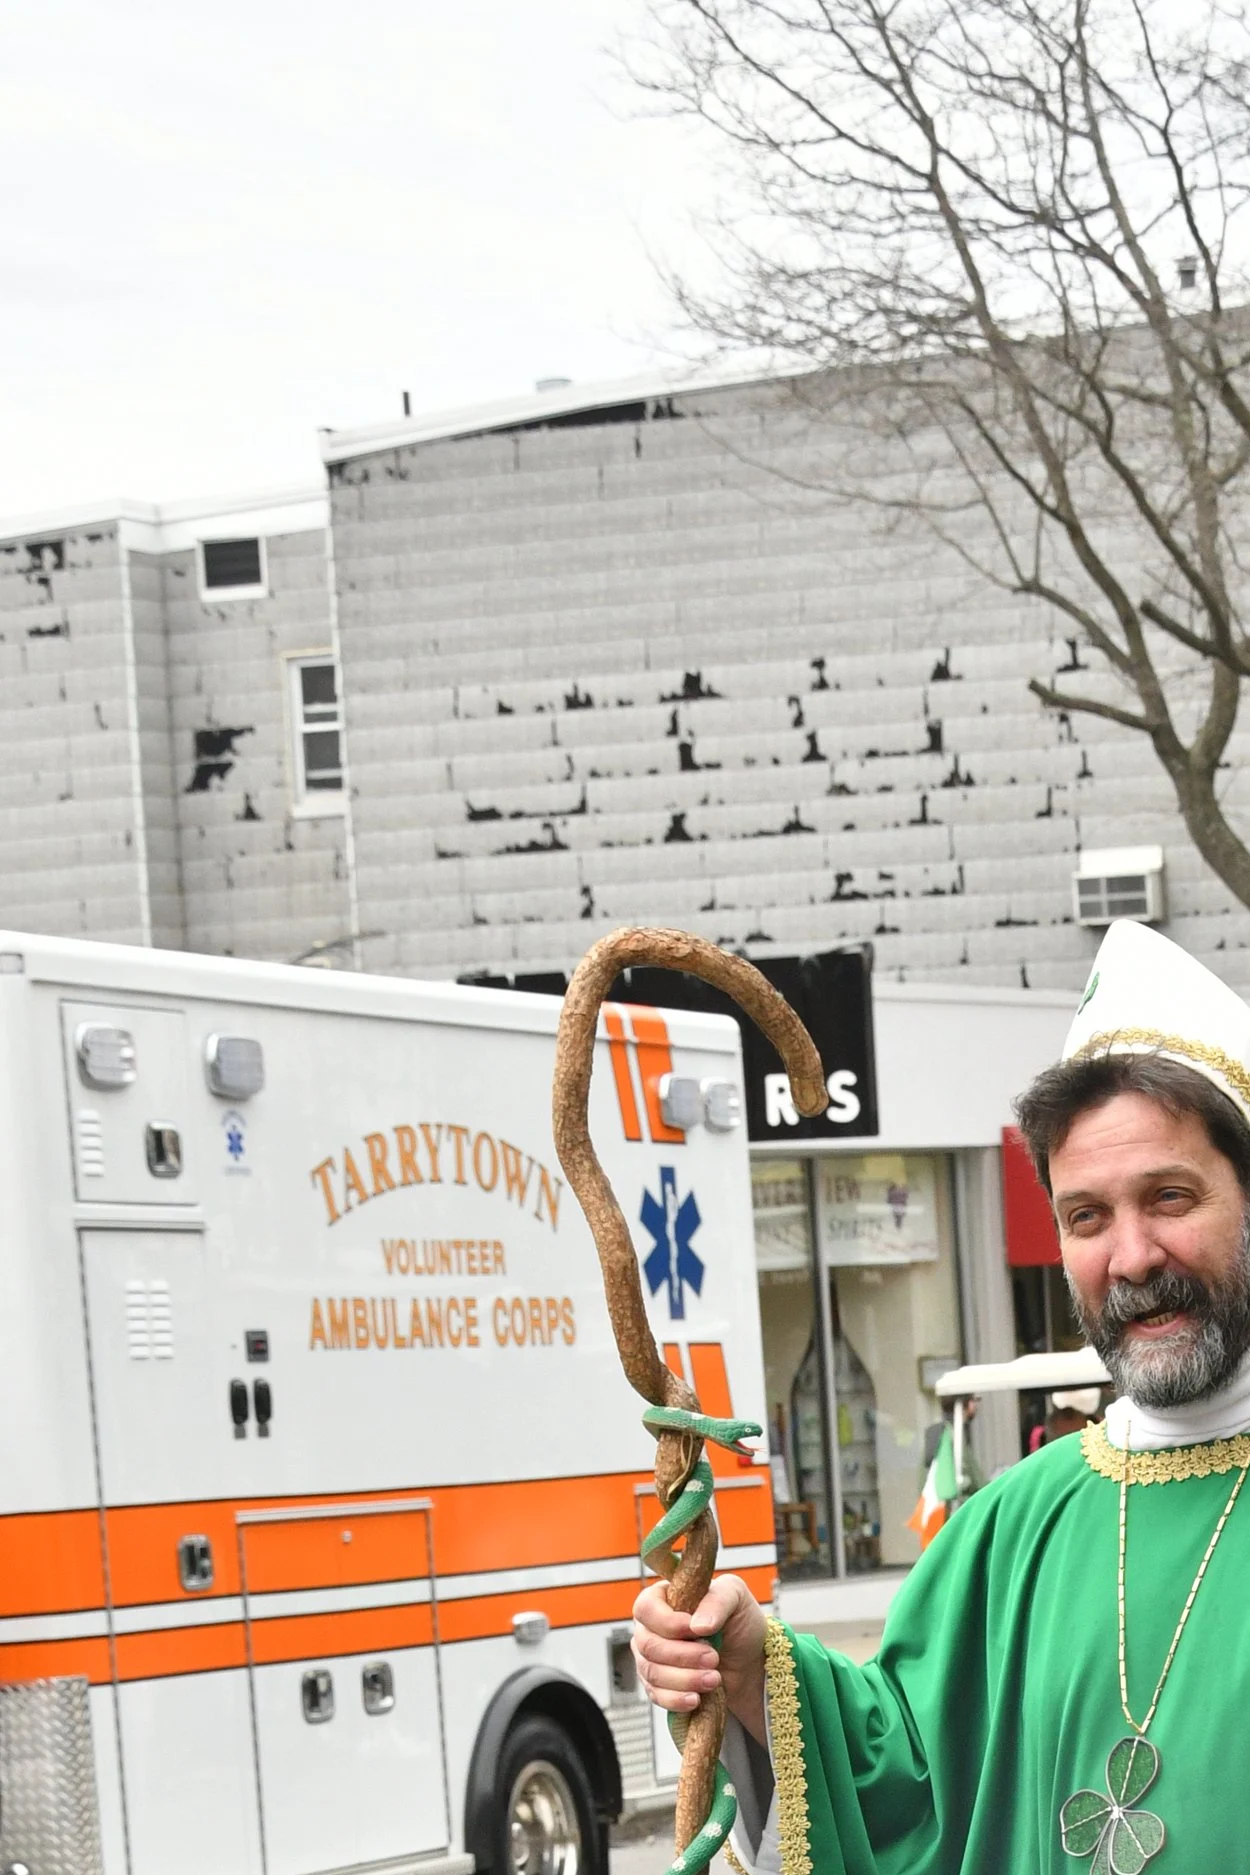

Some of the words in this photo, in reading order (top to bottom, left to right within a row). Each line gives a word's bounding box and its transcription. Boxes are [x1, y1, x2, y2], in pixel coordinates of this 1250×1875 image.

[309, 1121, 566, 1234] TARRYTOWN
[380, 1238, 507, 1277] VOLUNTEER
[308, 1296, 481, 1351] AMBULANCE
[491, 1296, 577, 1348] CORPS
